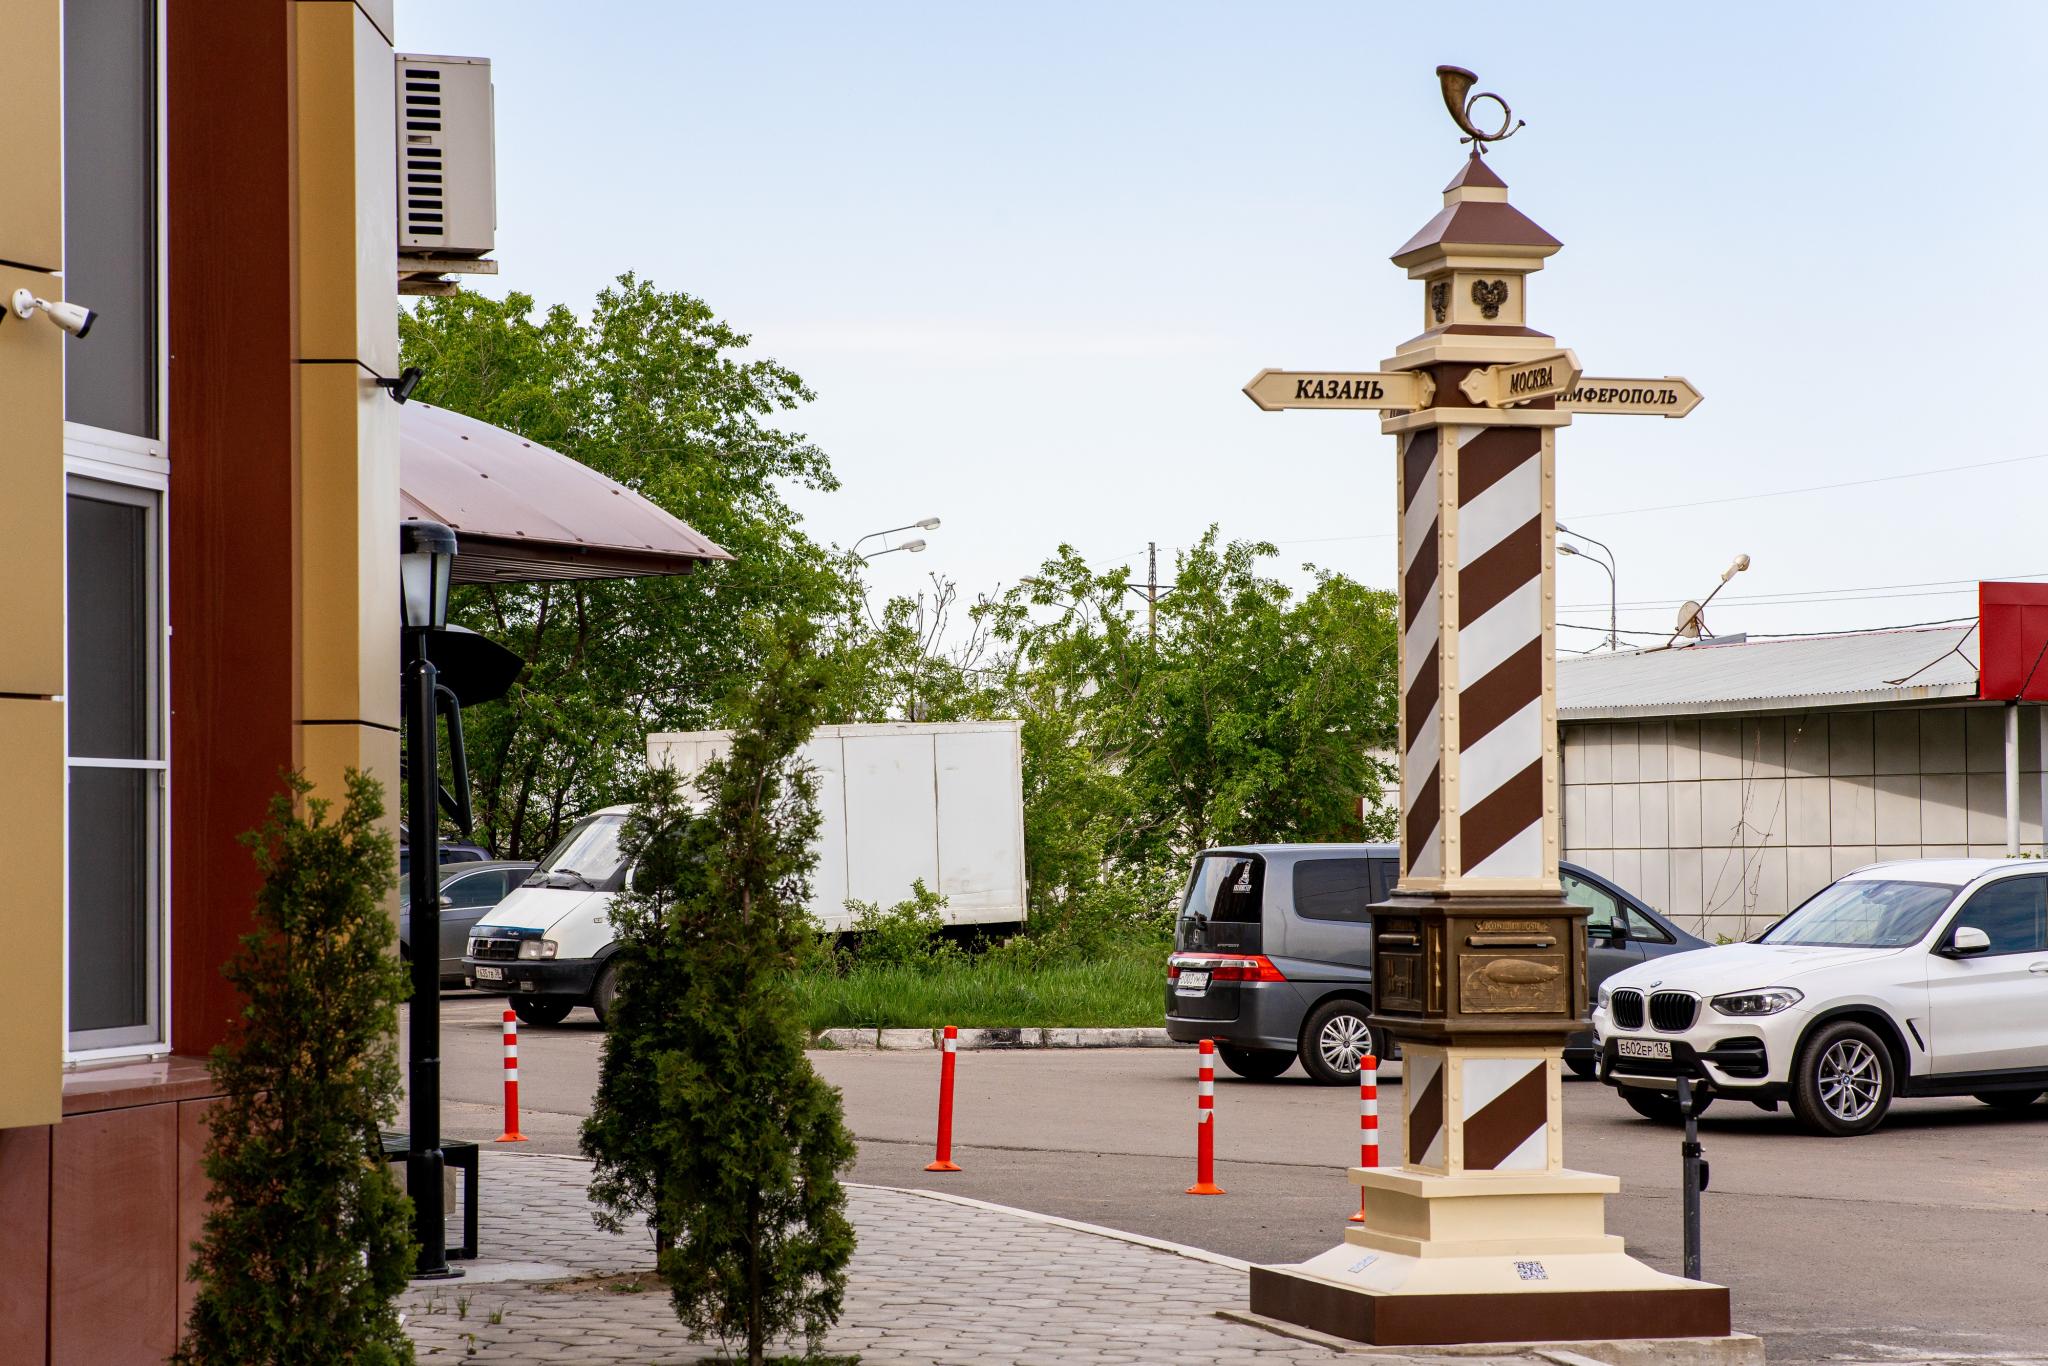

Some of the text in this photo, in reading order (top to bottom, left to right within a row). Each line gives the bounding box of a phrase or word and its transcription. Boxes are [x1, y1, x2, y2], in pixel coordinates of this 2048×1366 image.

[1510, 366, 1553, 393] МОСКВА
[1295, 379, 1384, 399] КАЗАНЬ
[1556, 387, 1678, 404] МФЕРОПОЛЬ
[1655, 1042, 1668, 1053] 136
